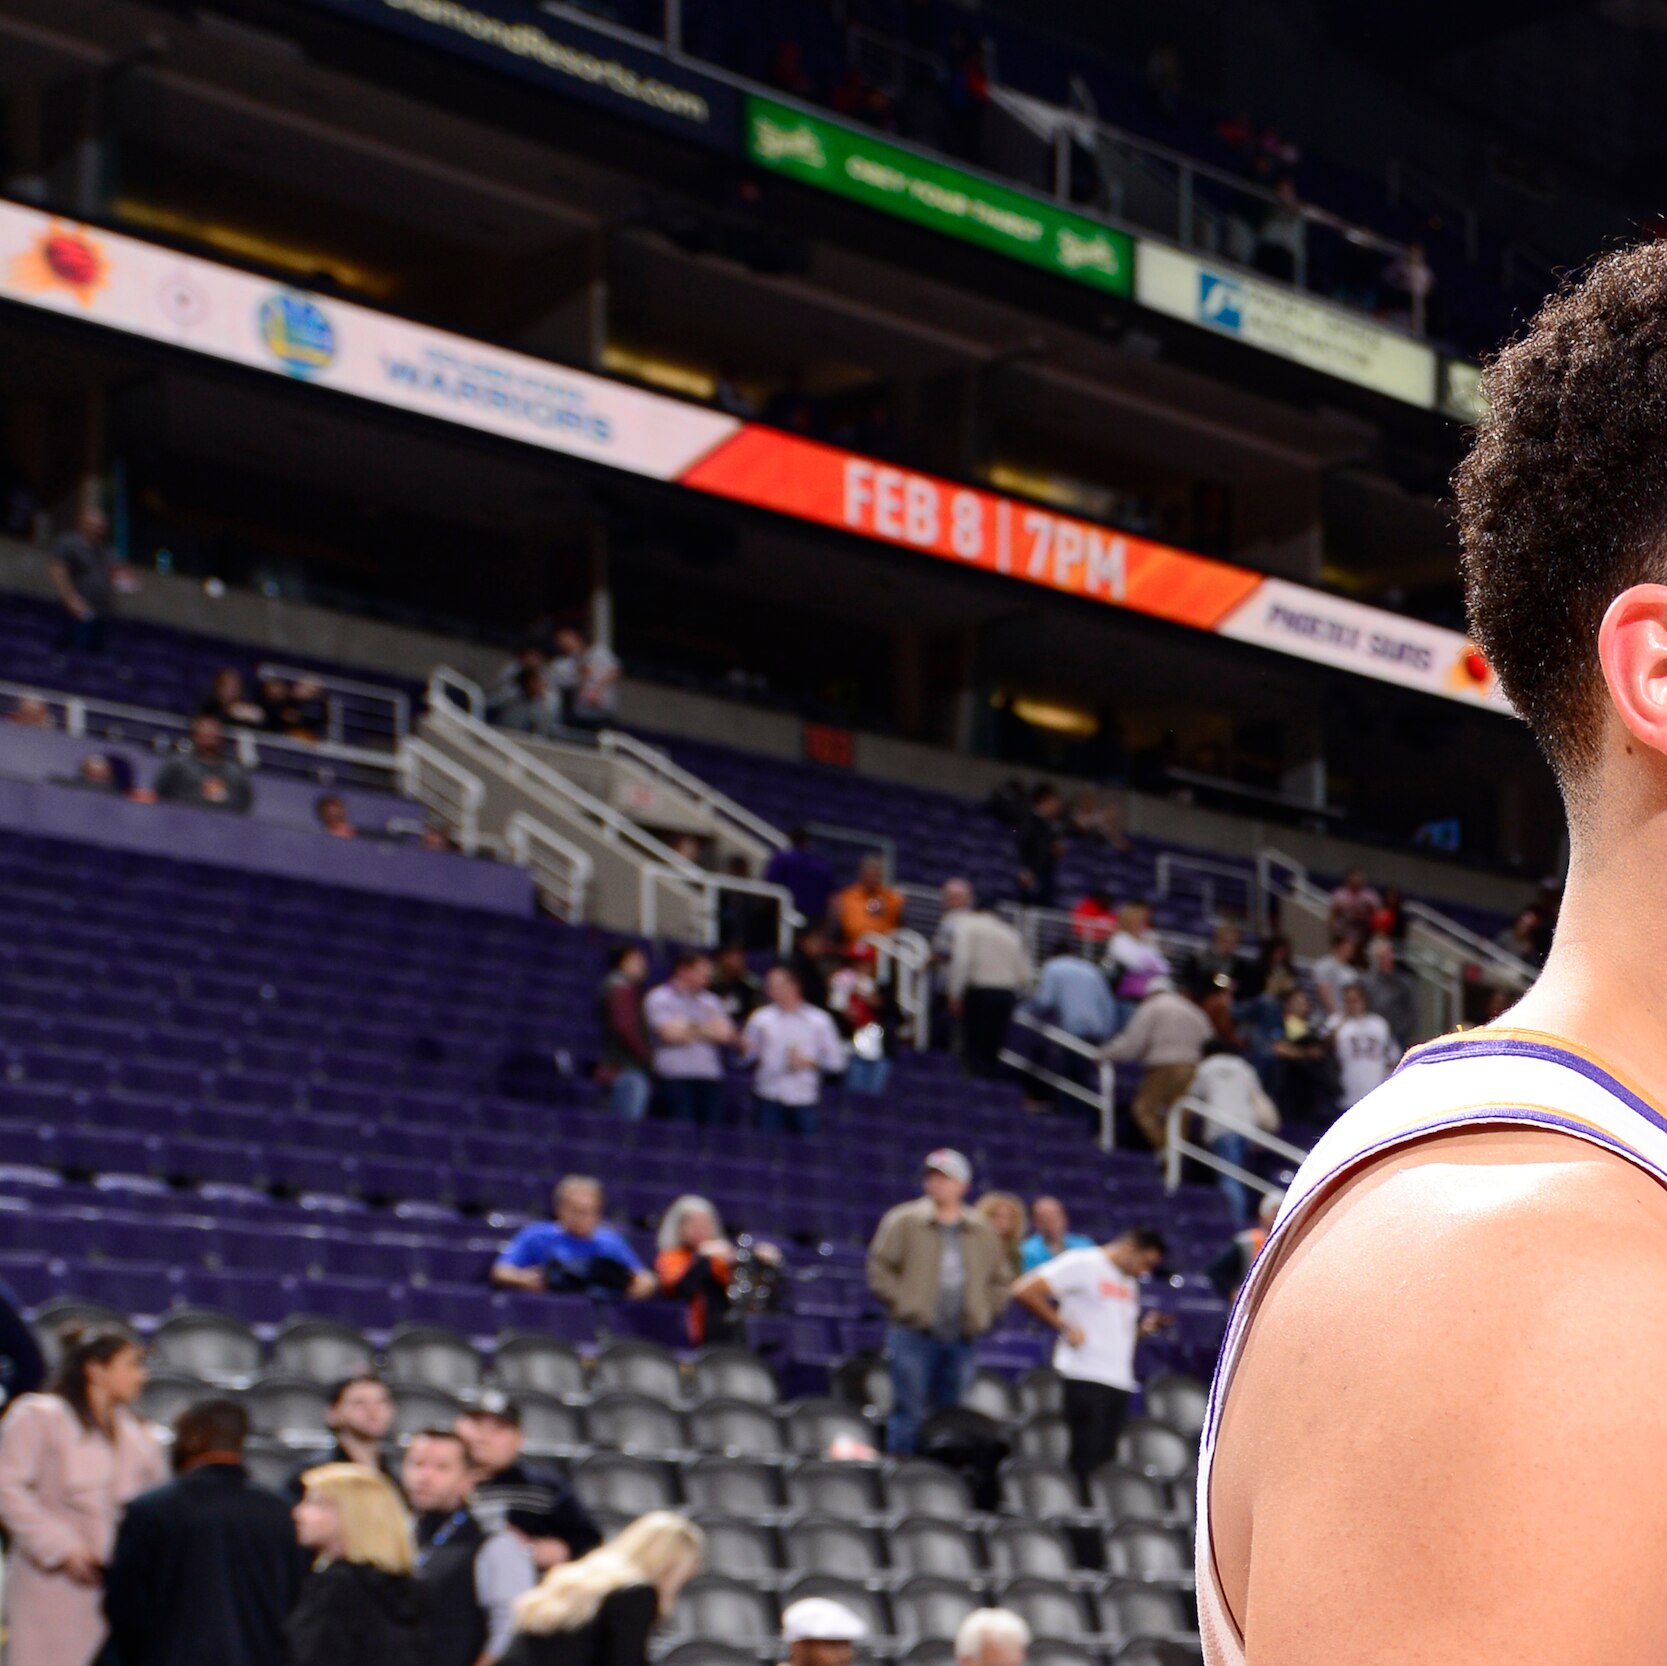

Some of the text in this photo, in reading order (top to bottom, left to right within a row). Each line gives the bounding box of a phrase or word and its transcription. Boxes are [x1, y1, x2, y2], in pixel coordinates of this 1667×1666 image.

[379, 352, 613, 443] WARRIORS
[843, 457, 941, 548] FEB
[951, 489, 984, 560] 8
[1023, 509, 1127, 602] 7PM
